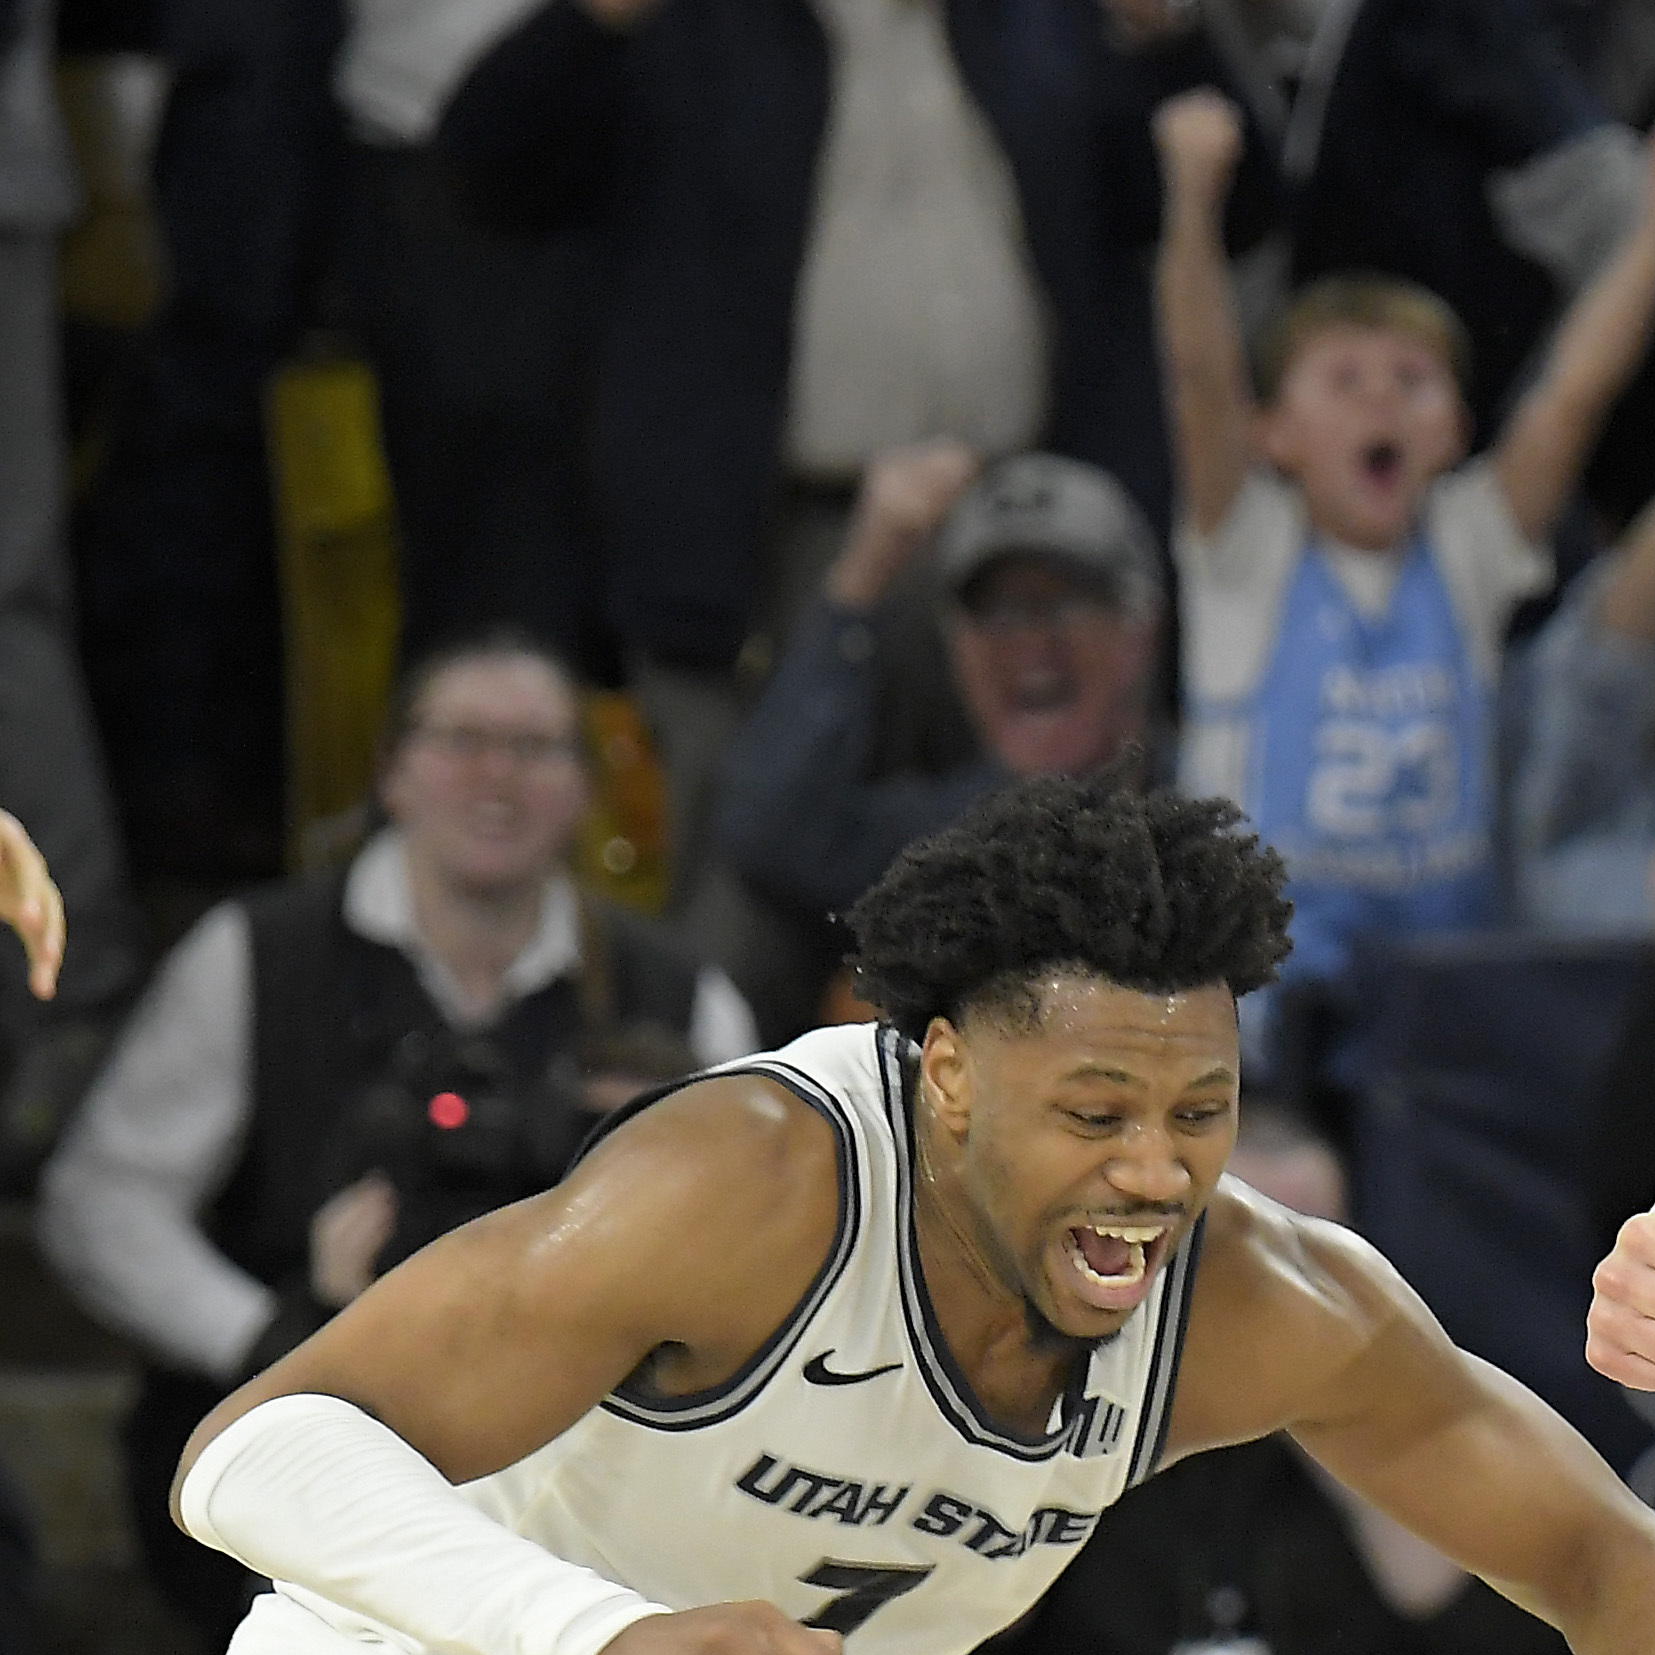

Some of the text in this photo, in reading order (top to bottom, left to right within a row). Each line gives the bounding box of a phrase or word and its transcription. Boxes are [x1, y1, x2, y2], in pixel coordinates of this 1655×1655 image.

[1308, 722, 1459, 833] 23
[735, 1454, 1100, 1560] UTAH STATE
[796, 1557, 937, 1638] 7
